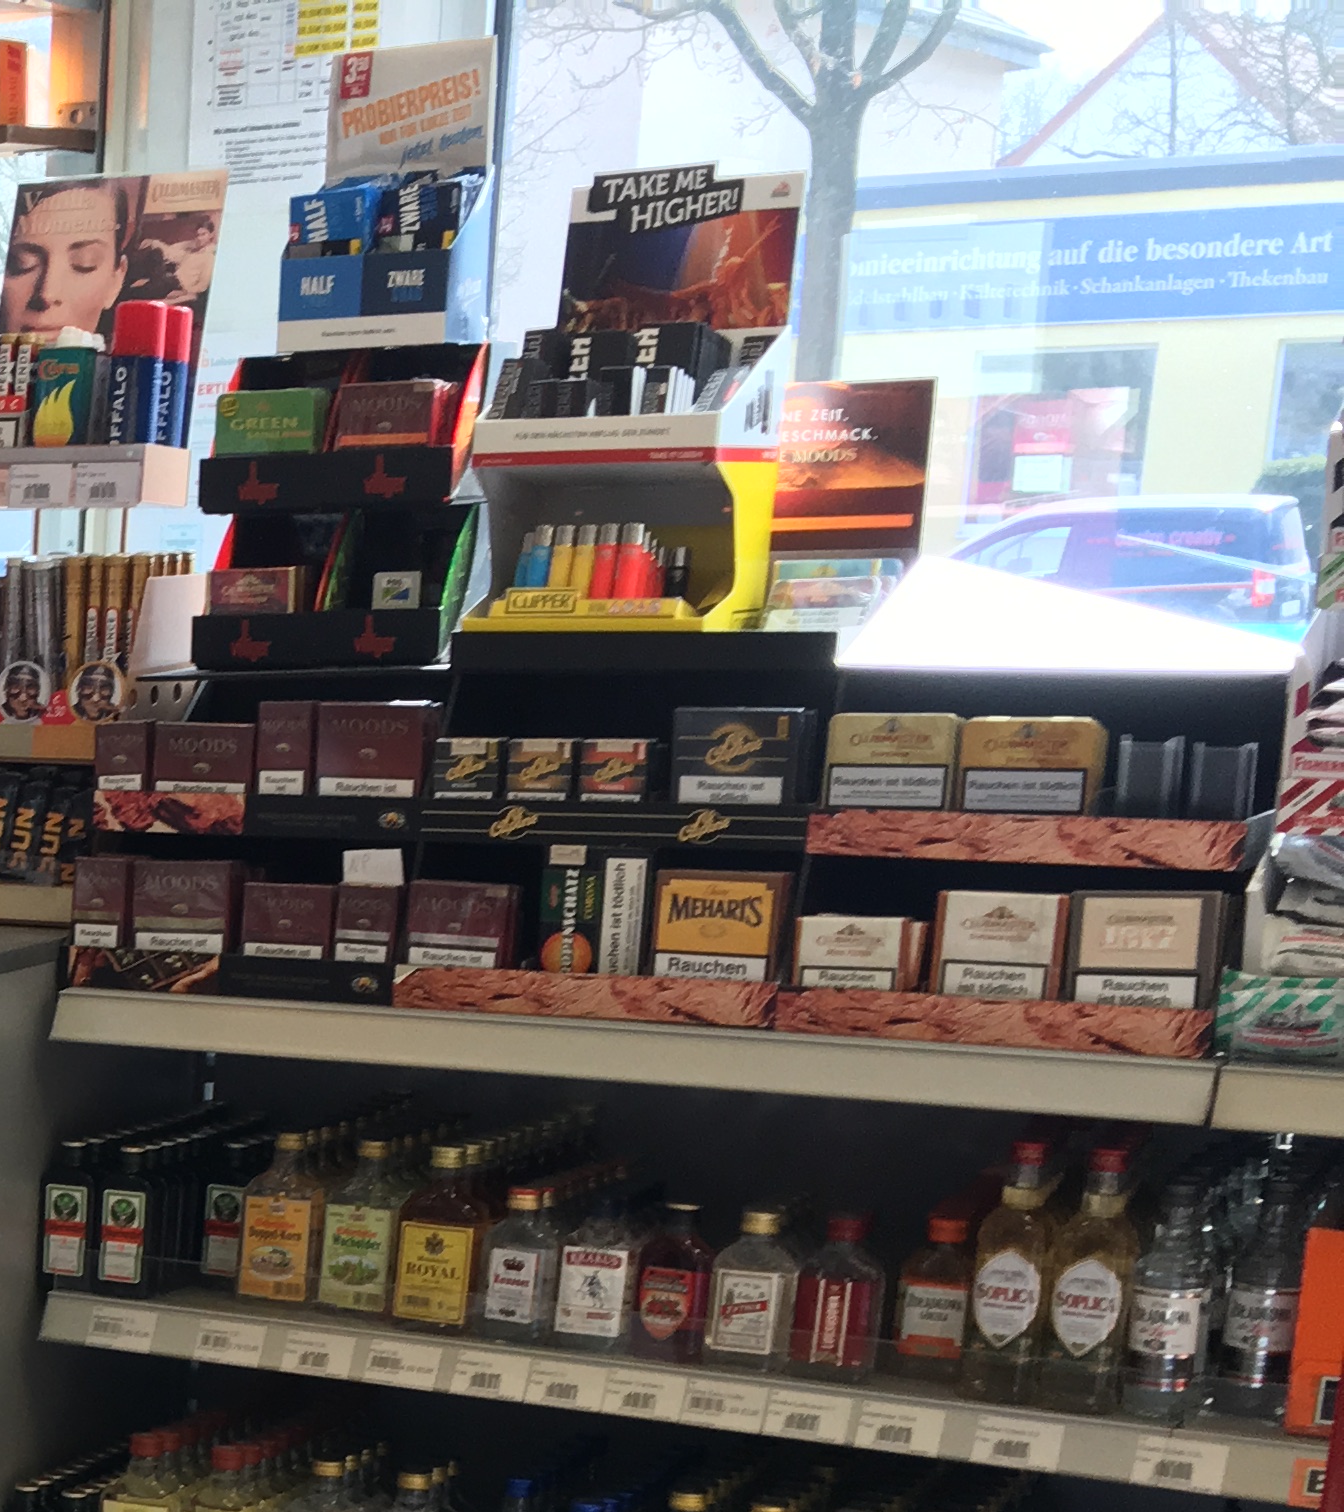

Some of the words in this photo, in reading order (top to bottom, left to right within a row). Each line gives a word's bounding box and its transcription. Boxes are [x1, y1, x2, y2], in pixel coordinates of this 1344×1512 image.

[342, 69, 480, 139] PROBIERPREIS!
[603, 173, 669, 204] TAKE
[674, 167, 708, 193] ME
[629, 187, 740, 233] HIGHER!
[305, 200, 329, 242] HALF
[1048, 238, 1093, 267] auf
[1098, 237, 1139, 264] die
[1146, 232, 1284, 260] besondere
[1291, 229, 1333, 254] Art
[300, 275, 335, 295] HALF
[388, 269, 426, 288] ZWARE
[1079, 272, 1215, 296] Schankanlagen
[1227, 268, 1329, 289] Thekenbau
[231, 416, 299, 432] GREEN
[791, 448, 857, 463] MOODS
[511, 591, 570, 611] CLIPPER
[169, 737, 238, 756] MOODS
[146, 873, 217, 893] MOODS
[669, 897, 762, 926] MEHARI'S
[669, 957, 748, 978] Rauchen
[961, 967, 1027, 983] Rauchen
[406, 1263, 461, 1283] ROYAL
